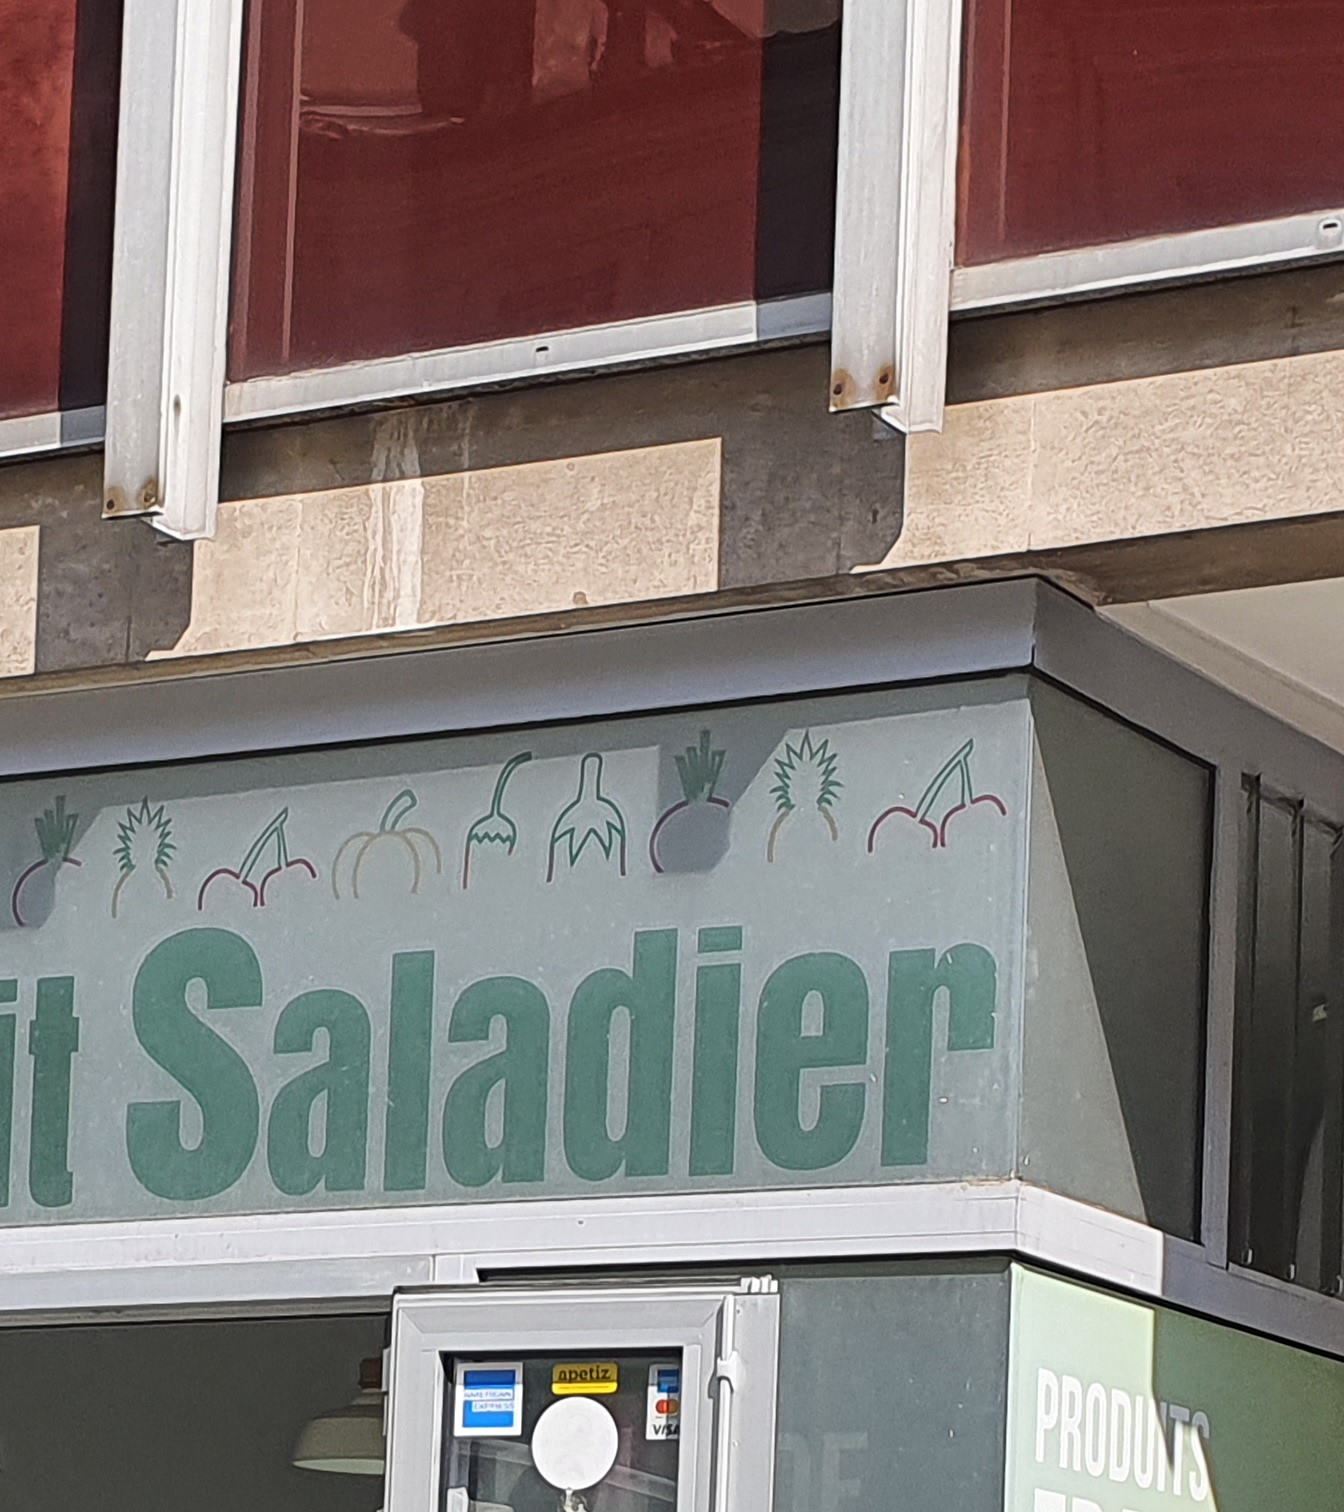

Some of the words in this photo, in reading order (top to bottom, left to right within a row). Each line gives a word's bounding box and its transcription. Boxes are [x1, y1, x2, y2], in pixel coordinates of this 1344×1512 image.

[125, 925, 996, 1201] Saladier
[557, 1365, 611, 1383] apetiz
[463, 1389, 512, 1399] AMERICAN
[474, 1402, 515, 1411] EXPRESS
[652, 1424, 680, 1436] VISA
[1034, 1367, 1210, 1502] PRODUITS
